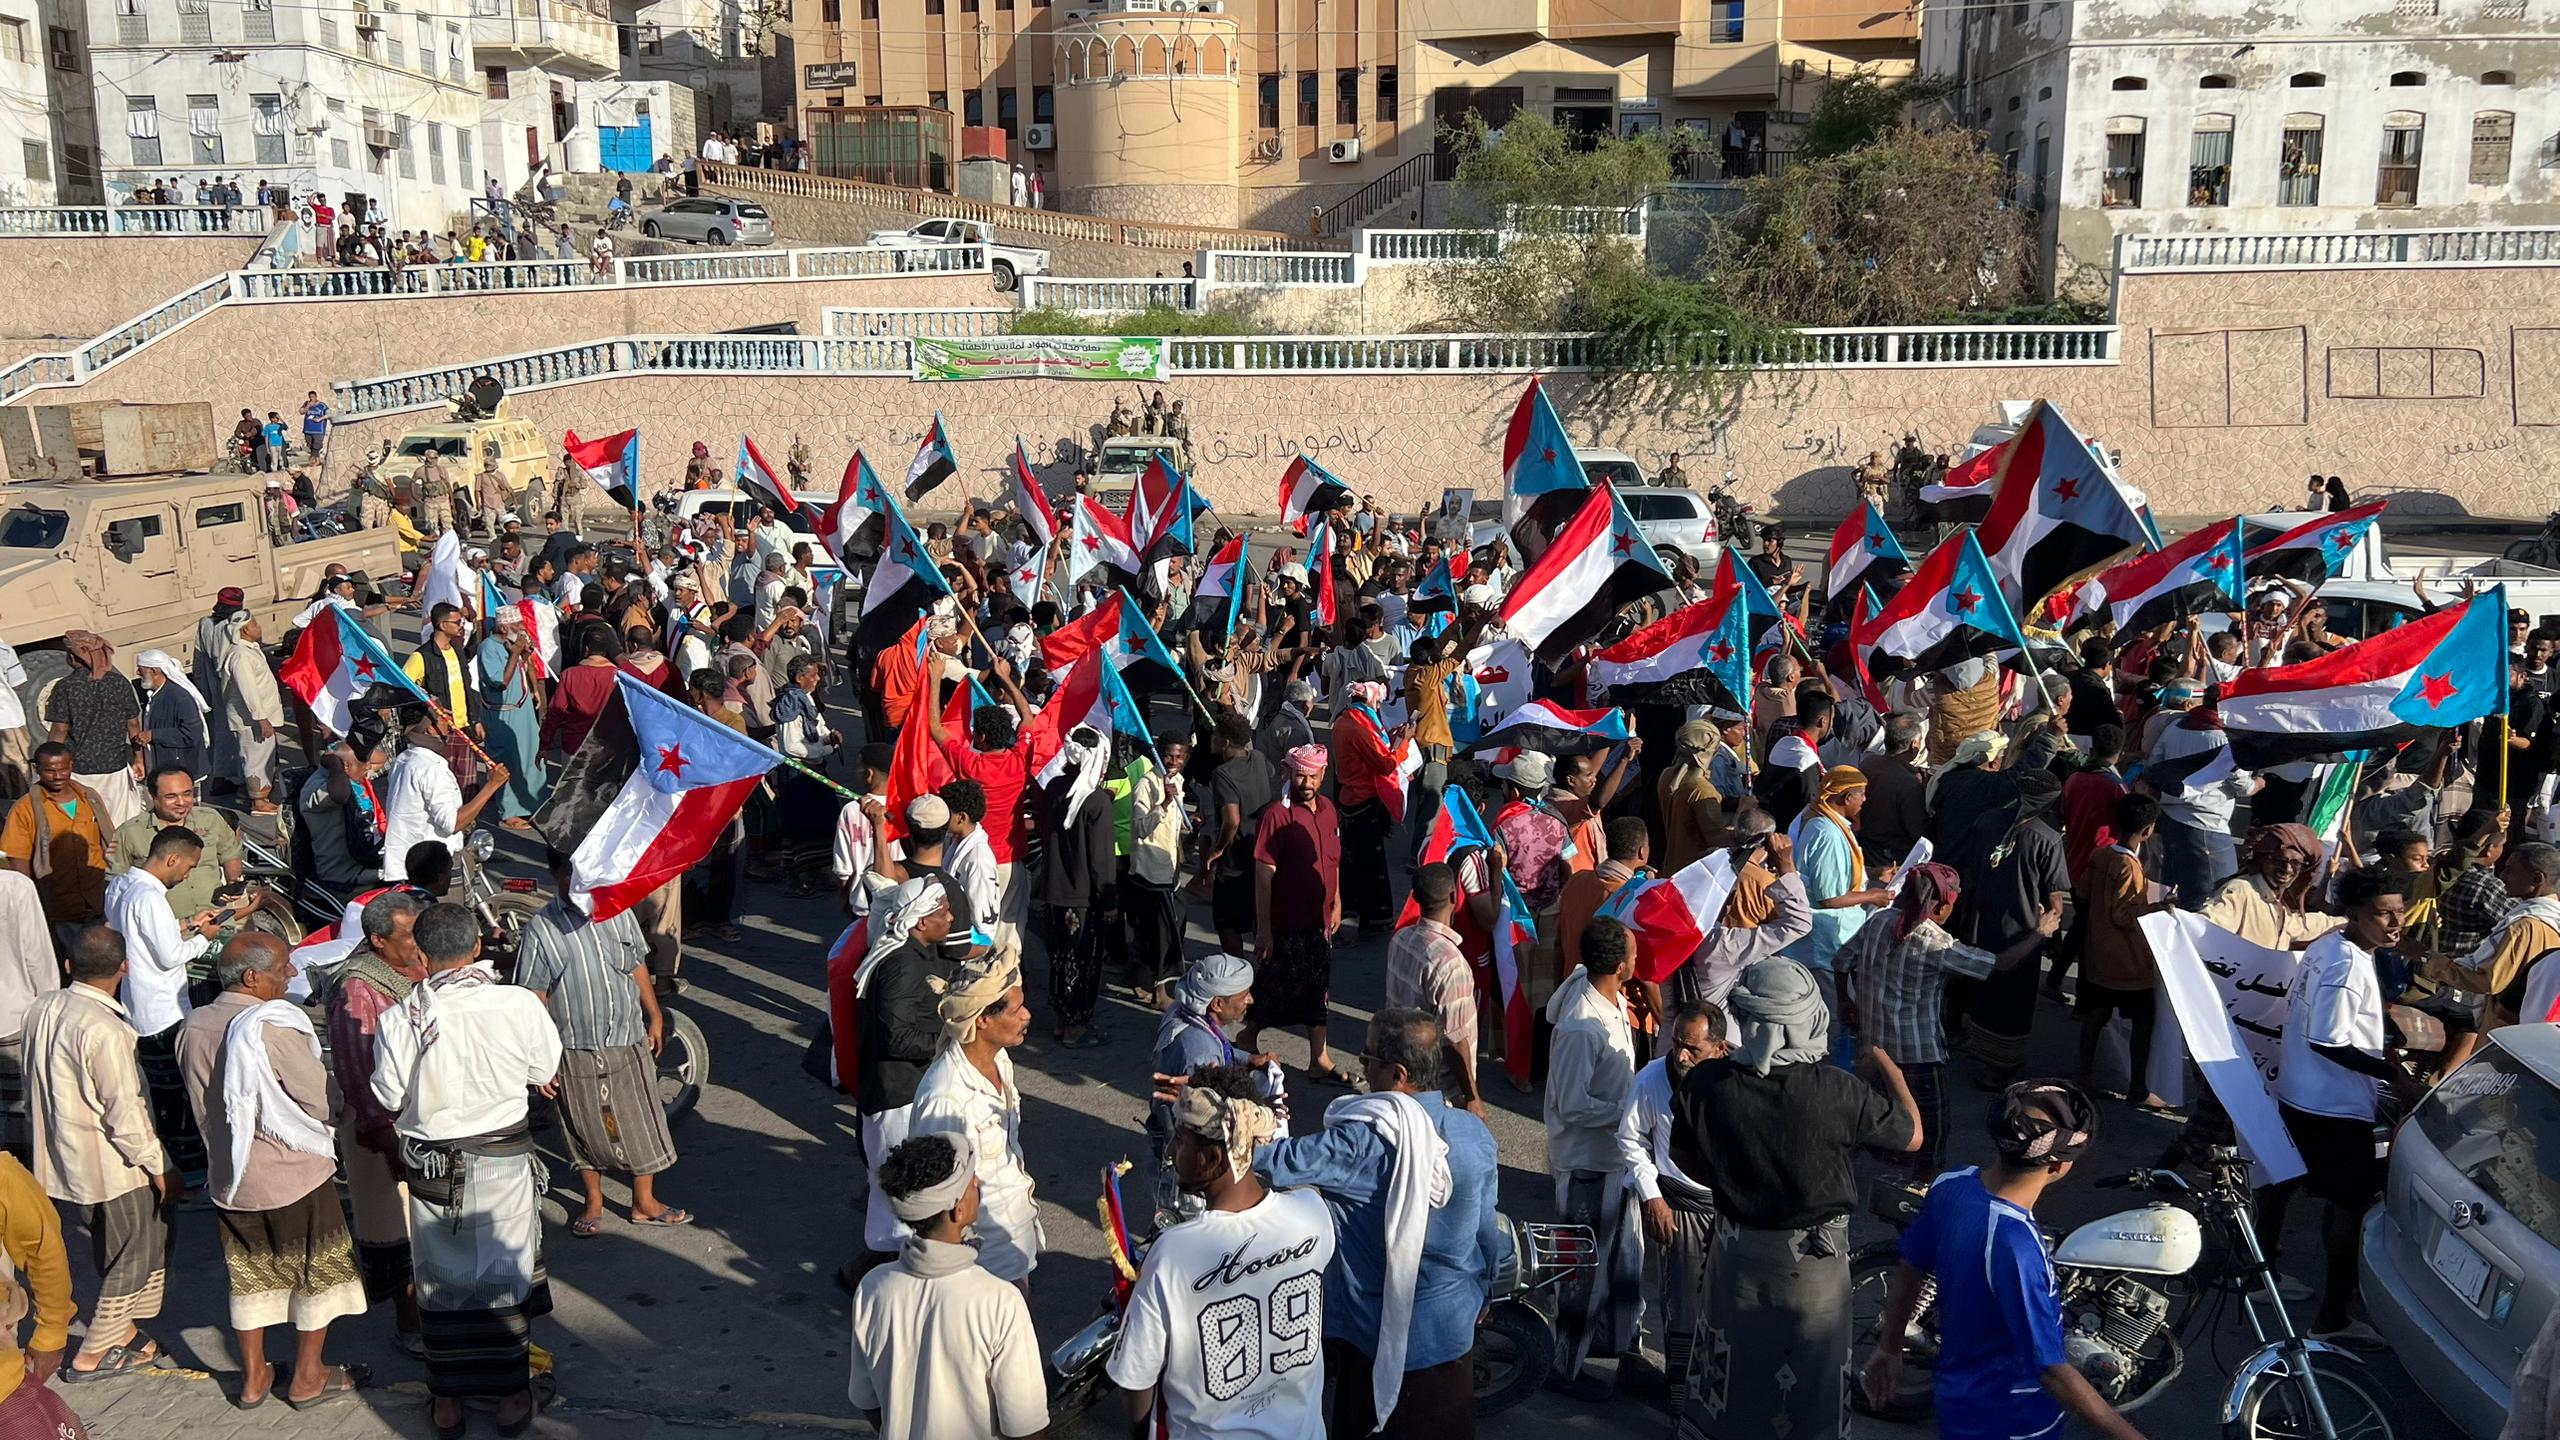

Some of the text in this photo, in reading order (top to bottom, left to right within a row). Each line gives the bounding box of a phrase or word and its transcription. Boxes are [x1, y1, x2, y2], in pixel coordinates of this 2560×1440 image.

[954, 353, 1002, 368] كبرى
[1004, 354, 1082, 368] تخفيضات
[1085, 357, 1111, 369] عن
[1192, 1232, 1320, 1293] Howa
[1197, 1268, 1323, 1402] 09
